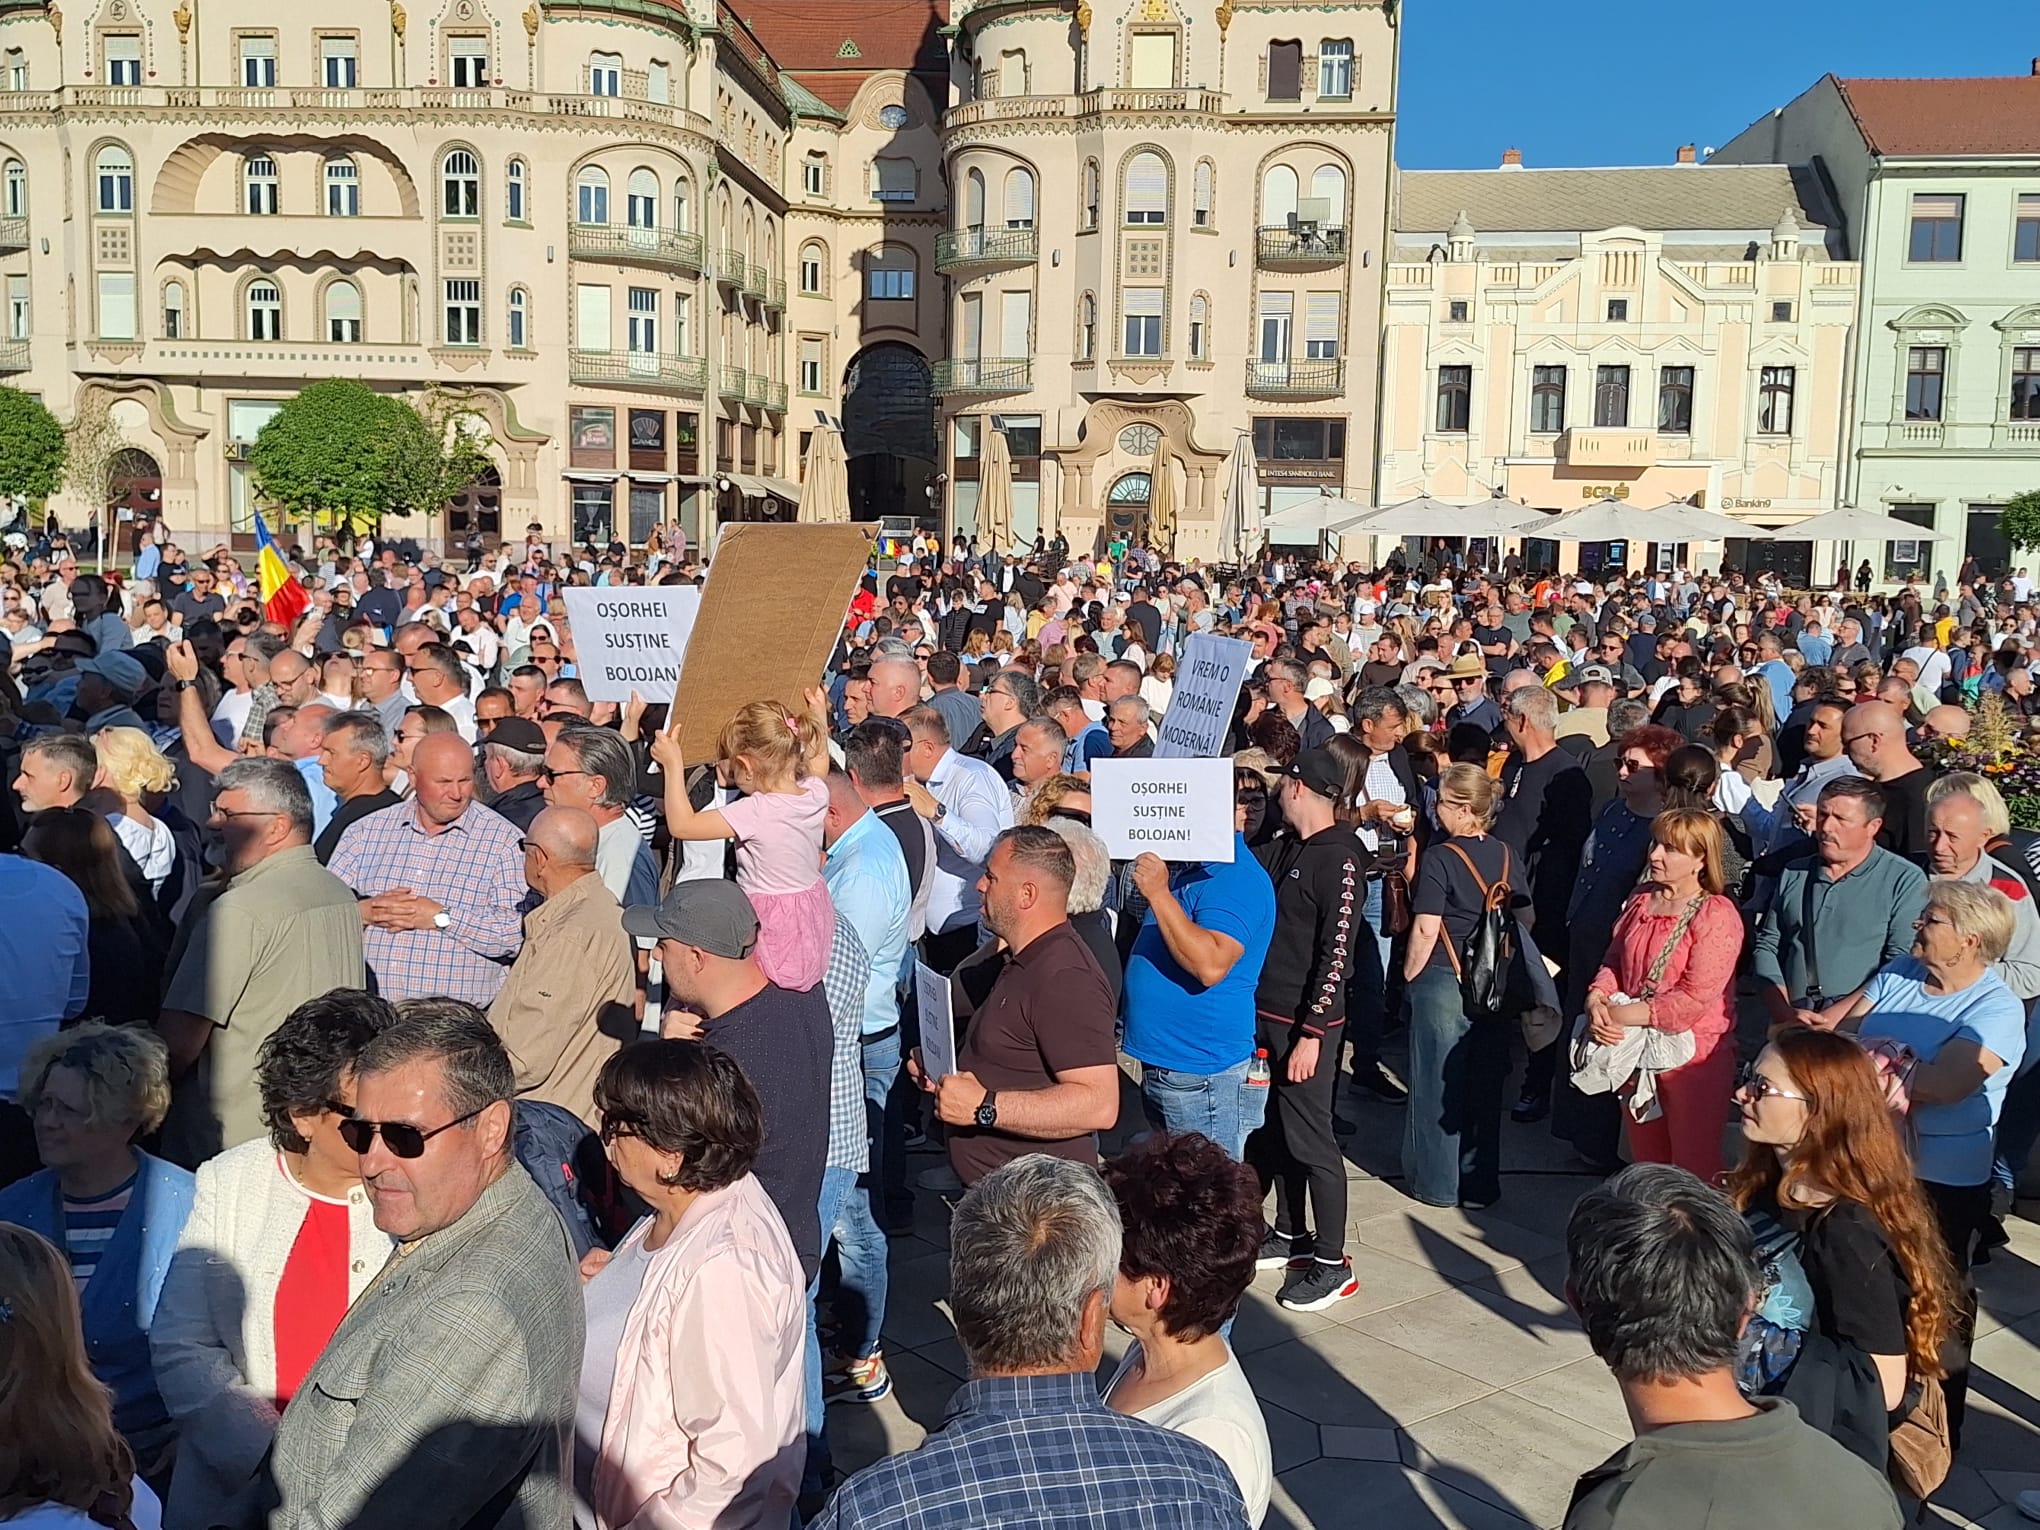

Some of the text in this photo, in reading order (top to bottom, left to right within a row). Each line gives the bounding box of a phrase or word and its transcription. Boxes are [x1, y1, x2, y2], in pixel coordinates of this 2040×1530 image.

[1318, 470, 1336, 478] BANK
[1191, 659, 1230, 682] VREM O
[1176, 691, 1224, 718] ROMÂNIE
[1161, 724, 1217, 755] MODERNĂ!
[1128, 828, 1191, 841] BOLOJAN!
